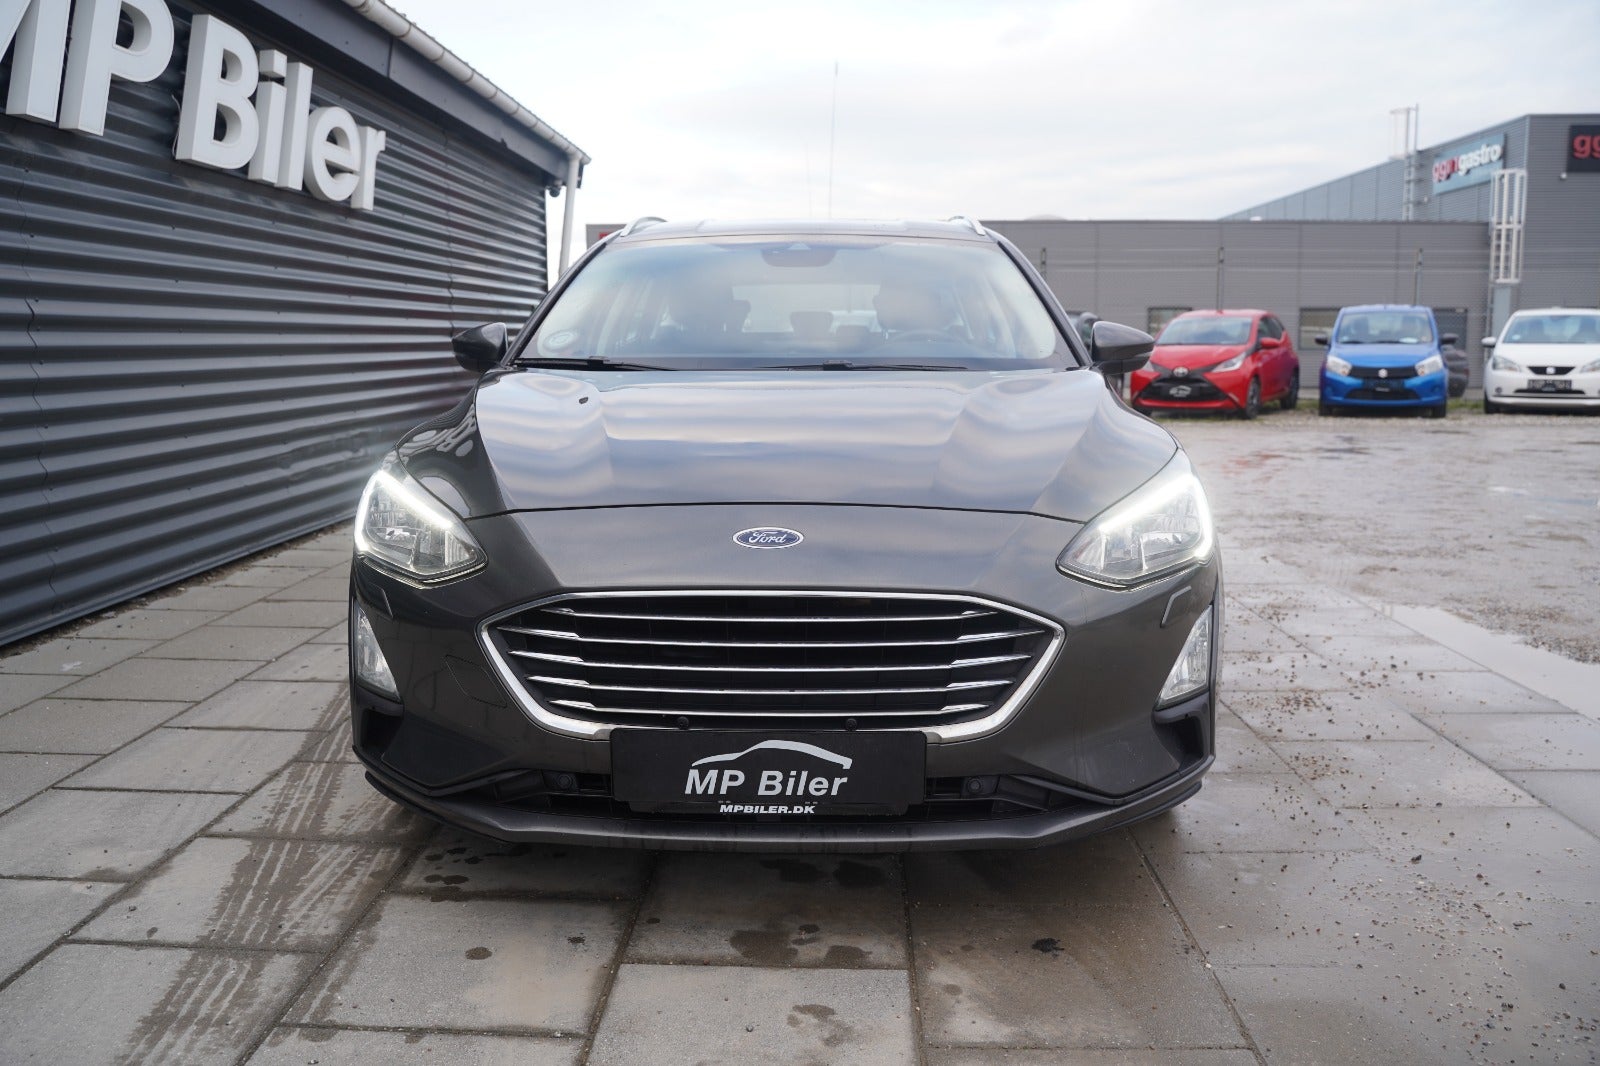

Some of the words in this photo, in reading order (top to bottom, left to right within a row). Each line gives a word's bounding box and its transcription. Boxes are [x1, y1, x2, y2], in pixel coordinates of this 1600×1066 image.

[176, 14, 386, 211] Biler
[748, 531, 787, 543] Ford
[684, 769, 745, 795] MP
[757, 770, 848, 796] Biler
[720, 804, 815, 814] MPBILER.DK
